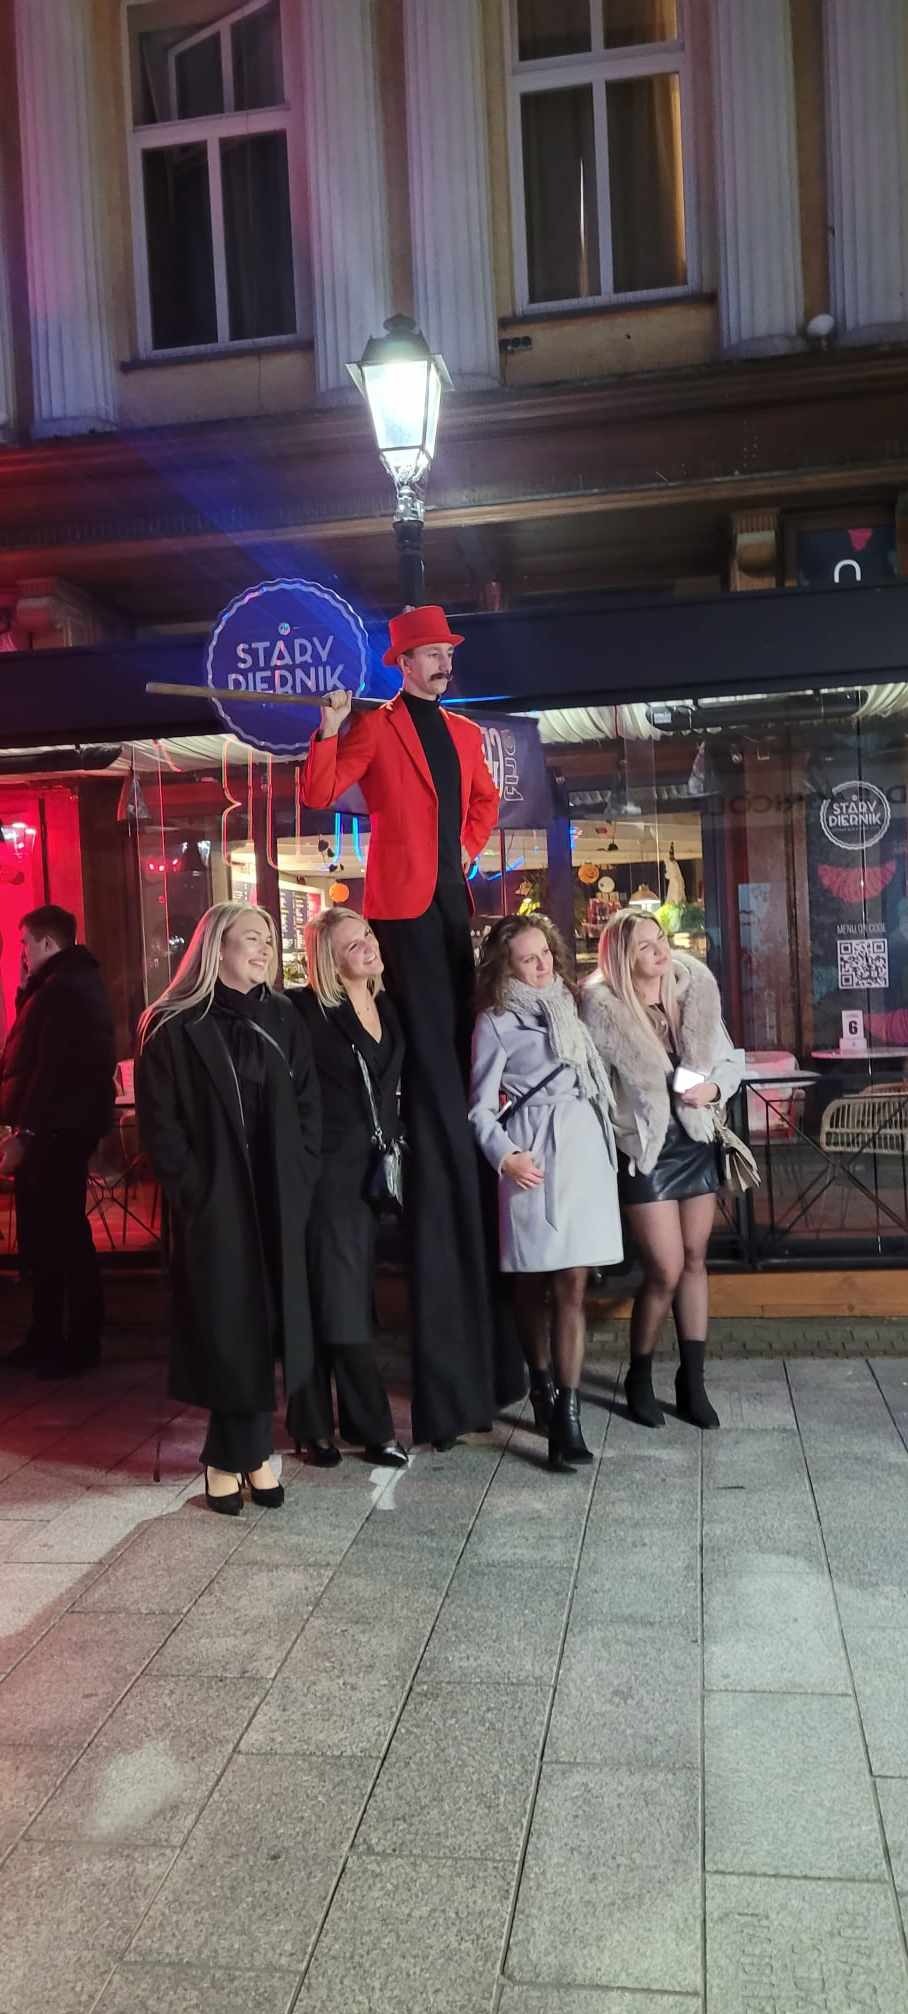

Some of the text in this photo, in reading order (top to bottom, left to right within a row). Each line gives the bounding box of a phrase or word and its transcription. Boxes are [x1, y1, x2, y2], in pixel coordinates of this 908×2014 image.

[236, 635, 334, 670] STARY
[832, 800, 877, 815] STARY
[828, 812, 882, 828] PIERNIK
[848, 1020, 858, 1035] 6
